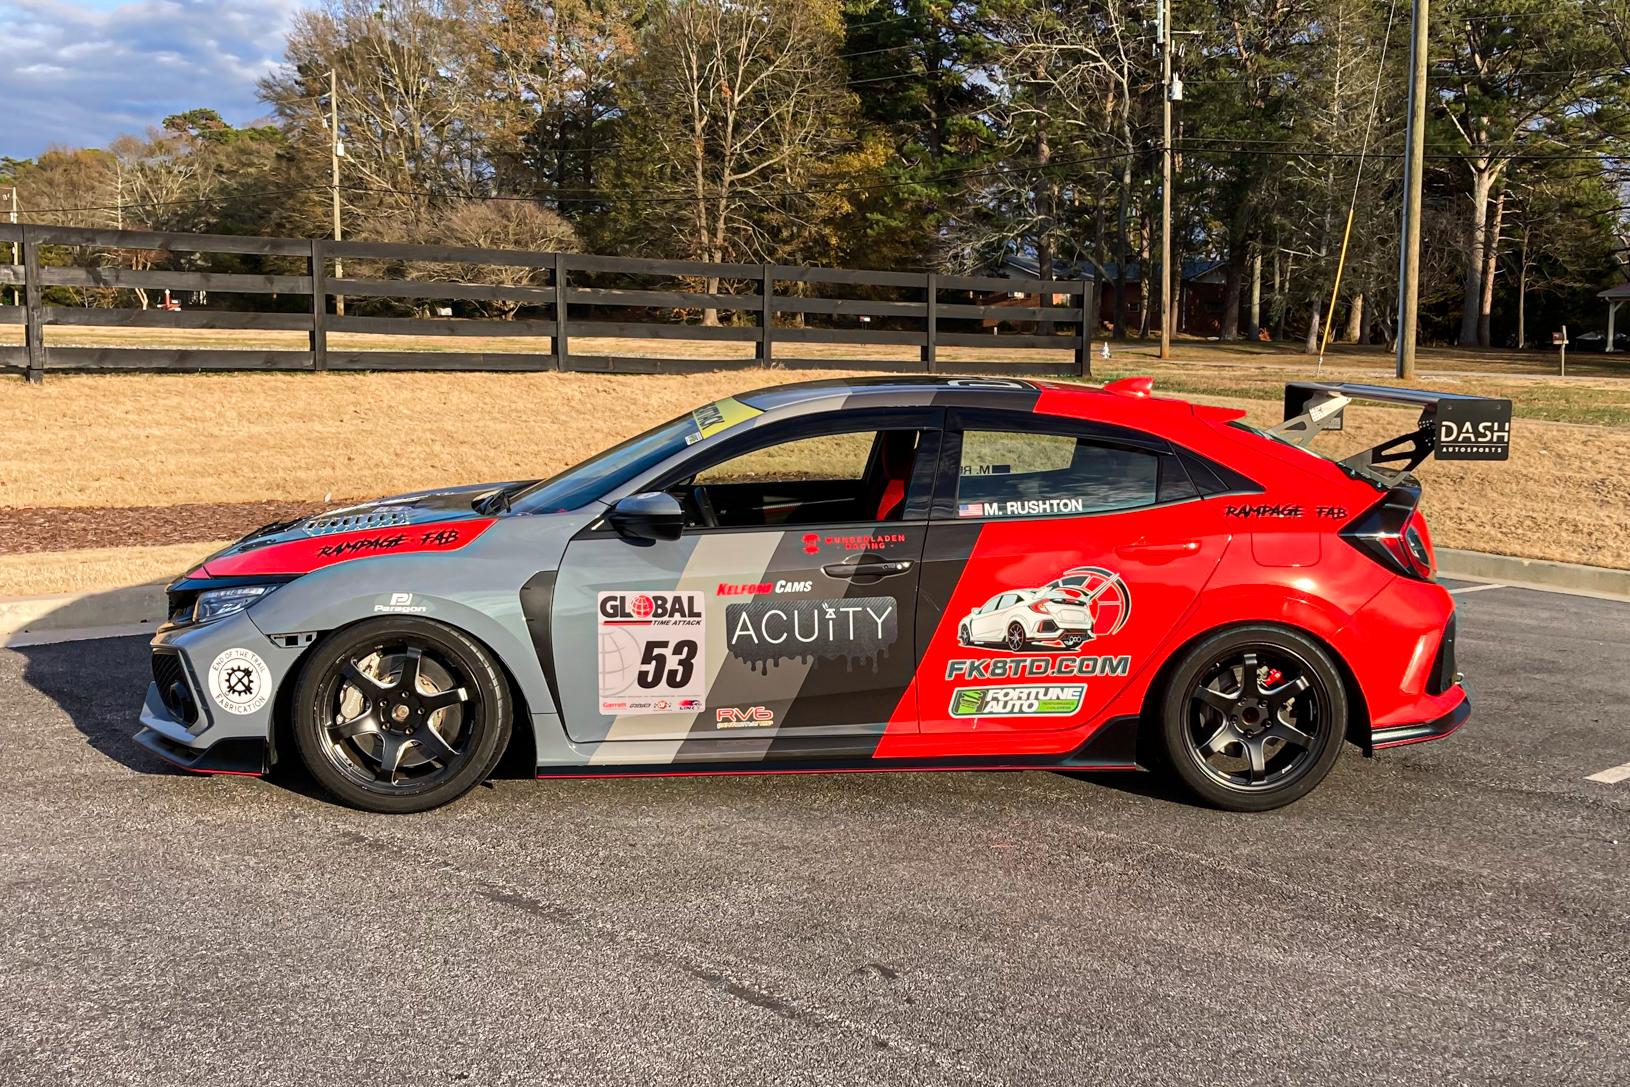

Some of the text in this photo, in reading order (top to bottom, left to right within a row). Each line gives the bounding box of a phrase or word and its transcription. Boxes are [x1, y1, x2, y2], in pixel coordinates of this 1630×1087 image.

[1441, 421, 1510, 442] DASH
[984, 499, 1083, 516] M. RUSHTON
[1225, 504, 1348, 520] RAMPAGE FAB
[317, 529, 459, 558] RAMPAGE FAB
[775, 580, 812, 593] CAMS
[374, 605, 427, 613] Paragon
[600, 596, 702, 618] GLOBAL
[212, 658, 225, 671] END
[225, 651, 233, 659] OF
[251, 654, 266, 673] TRAIL
[637, 640, 698, 689] 53
[945, 656, 1131, 680] FK8TD.COM
[215, 693, 266, 713] FABRICATION
[987, 687, 1083, 701] FORTUNE
[716, 706, 774, 722] RV6
[983, 700, 1040, 713] AUTO
